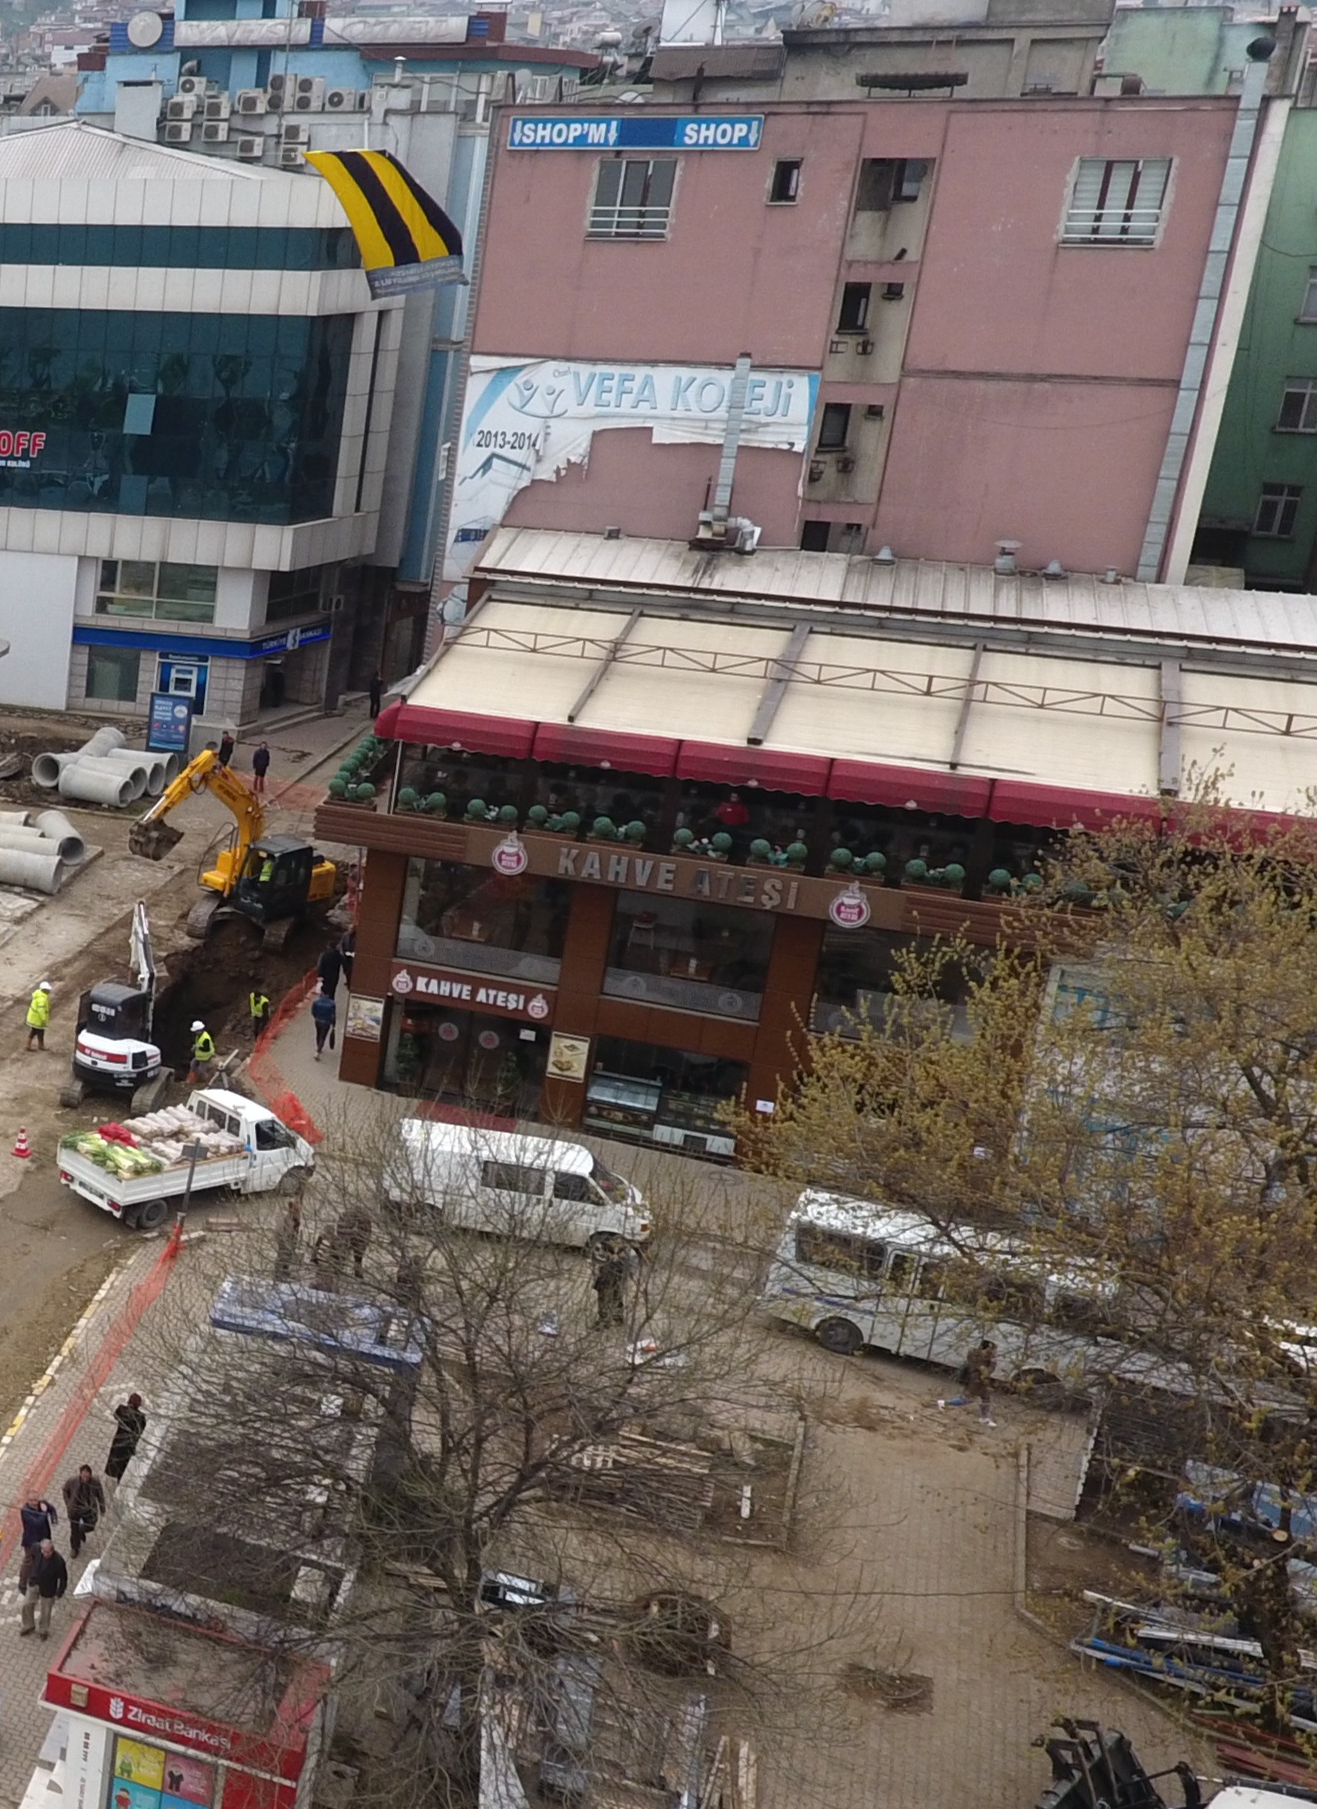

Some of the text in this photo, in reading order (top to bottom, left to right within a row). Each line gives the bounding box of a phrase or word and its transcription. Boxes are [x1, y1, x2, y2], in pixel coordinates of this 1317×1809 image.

[522, 122, 748, 144] SHOP'M SHOP
[572, 370, 657, 411] VEFA
[557, 847, 799, 911] KAHVE ATEŞİ
[416, 976, 472, 1000] KAHVE
